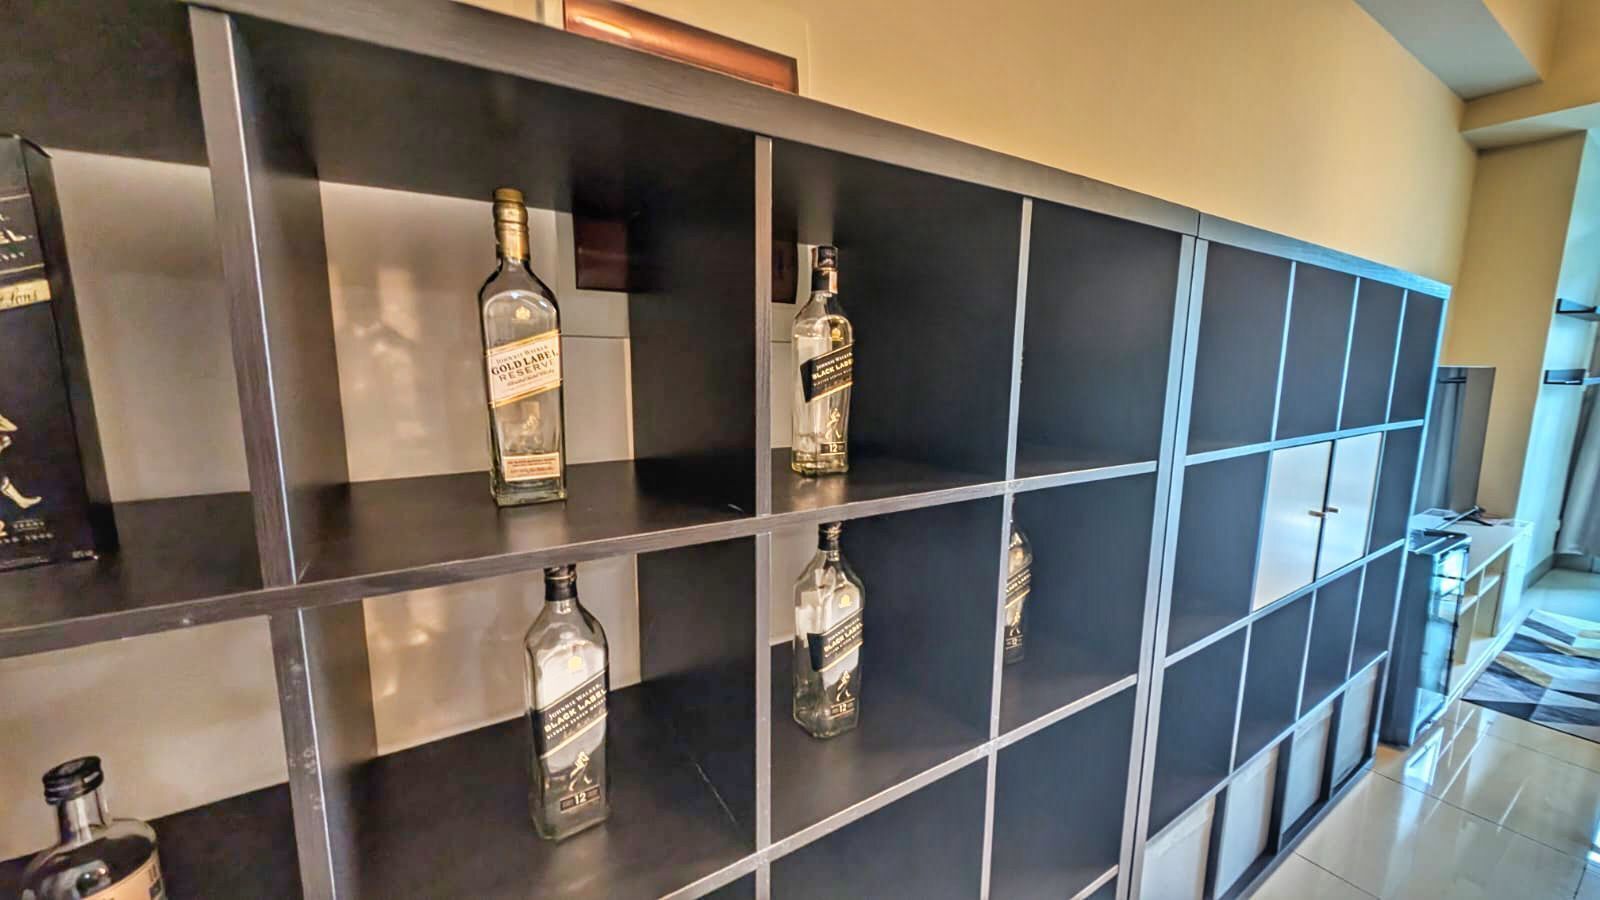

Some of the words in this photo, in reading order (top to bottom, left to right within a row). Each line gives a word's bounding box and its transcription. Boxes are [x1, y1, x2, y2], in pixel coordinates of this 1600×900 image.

[491, 360, 522, 376] GOLD
[523, 349, 558, 366] LABEL
[812, 366, 835, 380] BLACK
[829, 443, 838, 453] 12
[823, 635, 845, 653] BLACK
[544, 708, 577, 733] BLACK
[577, 688, 607, 711] LABEL
[839, 702, 847, 713] 12
[575, 791, 587, 805] 12
